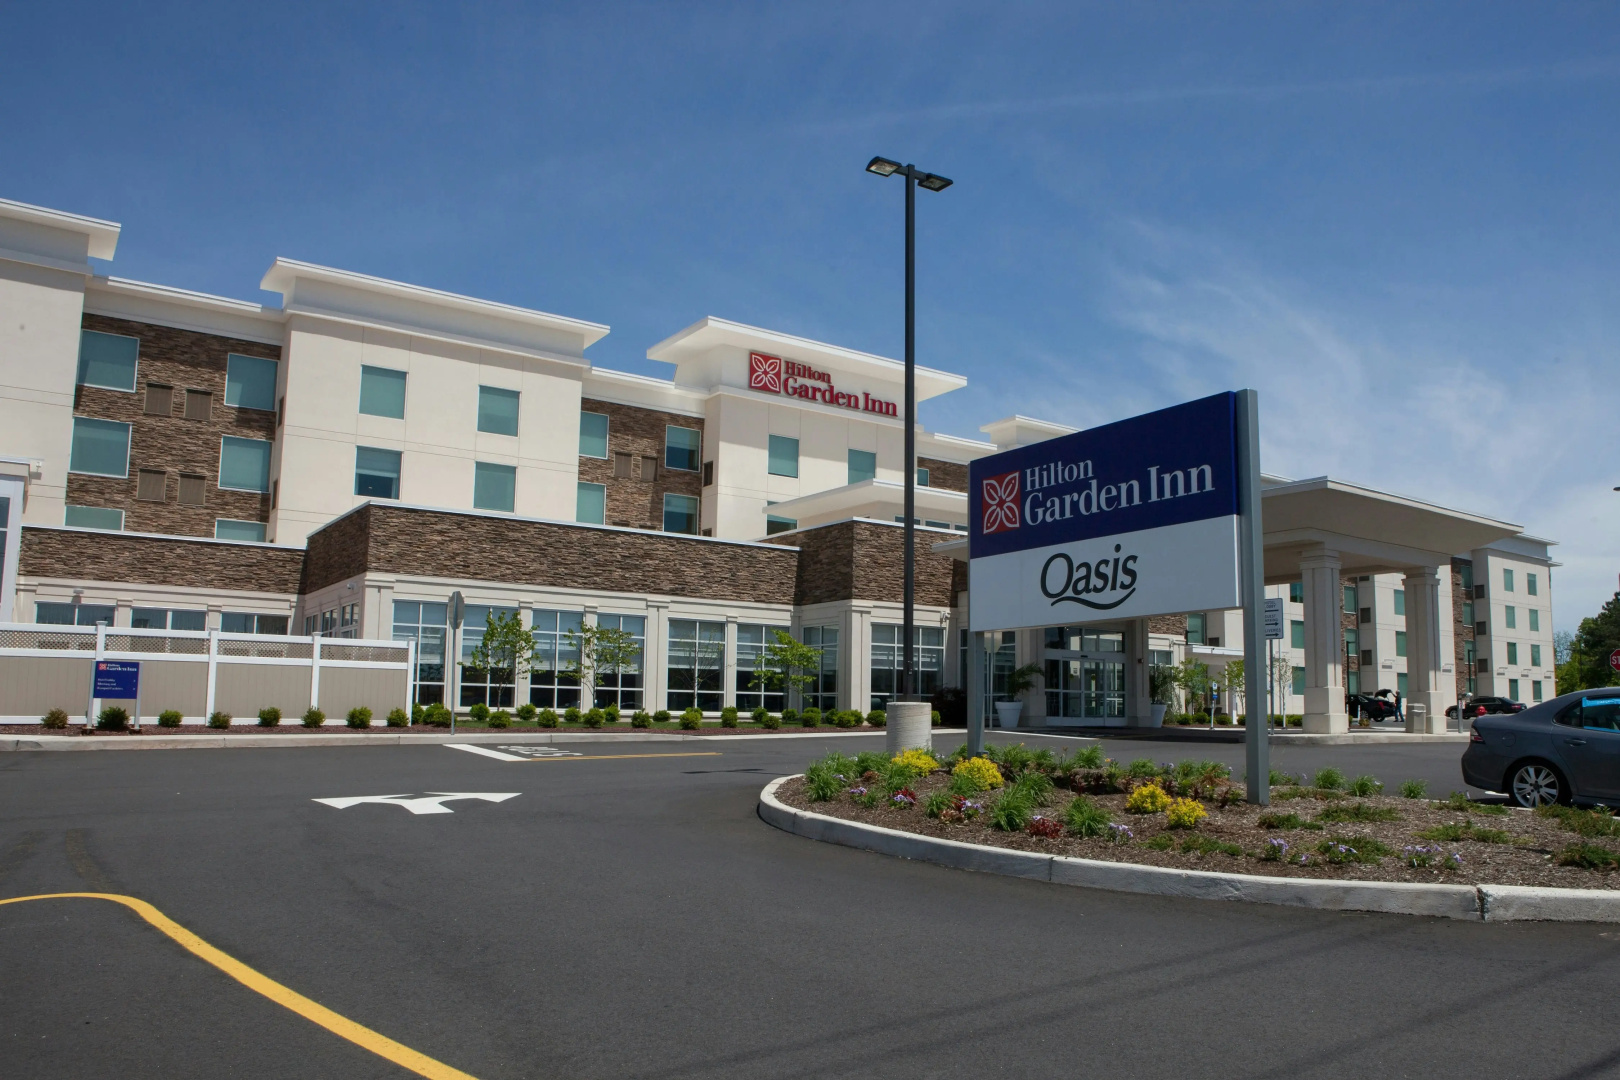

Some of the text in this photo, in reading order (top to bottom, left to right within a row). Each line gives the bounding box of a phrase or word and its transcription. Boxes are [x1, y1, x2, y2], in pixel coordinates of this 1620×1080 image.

[784, 360, 832, 384] Hilton
[783, 376, 898, 417] Garden Inn
[1024, 459, 1094, 492] Hilton
[1024, 463, 1216, 526] Garden Inn
[1040, 543, 1139, 600] Oasis
[1611, 655, 1620, 665] ST
